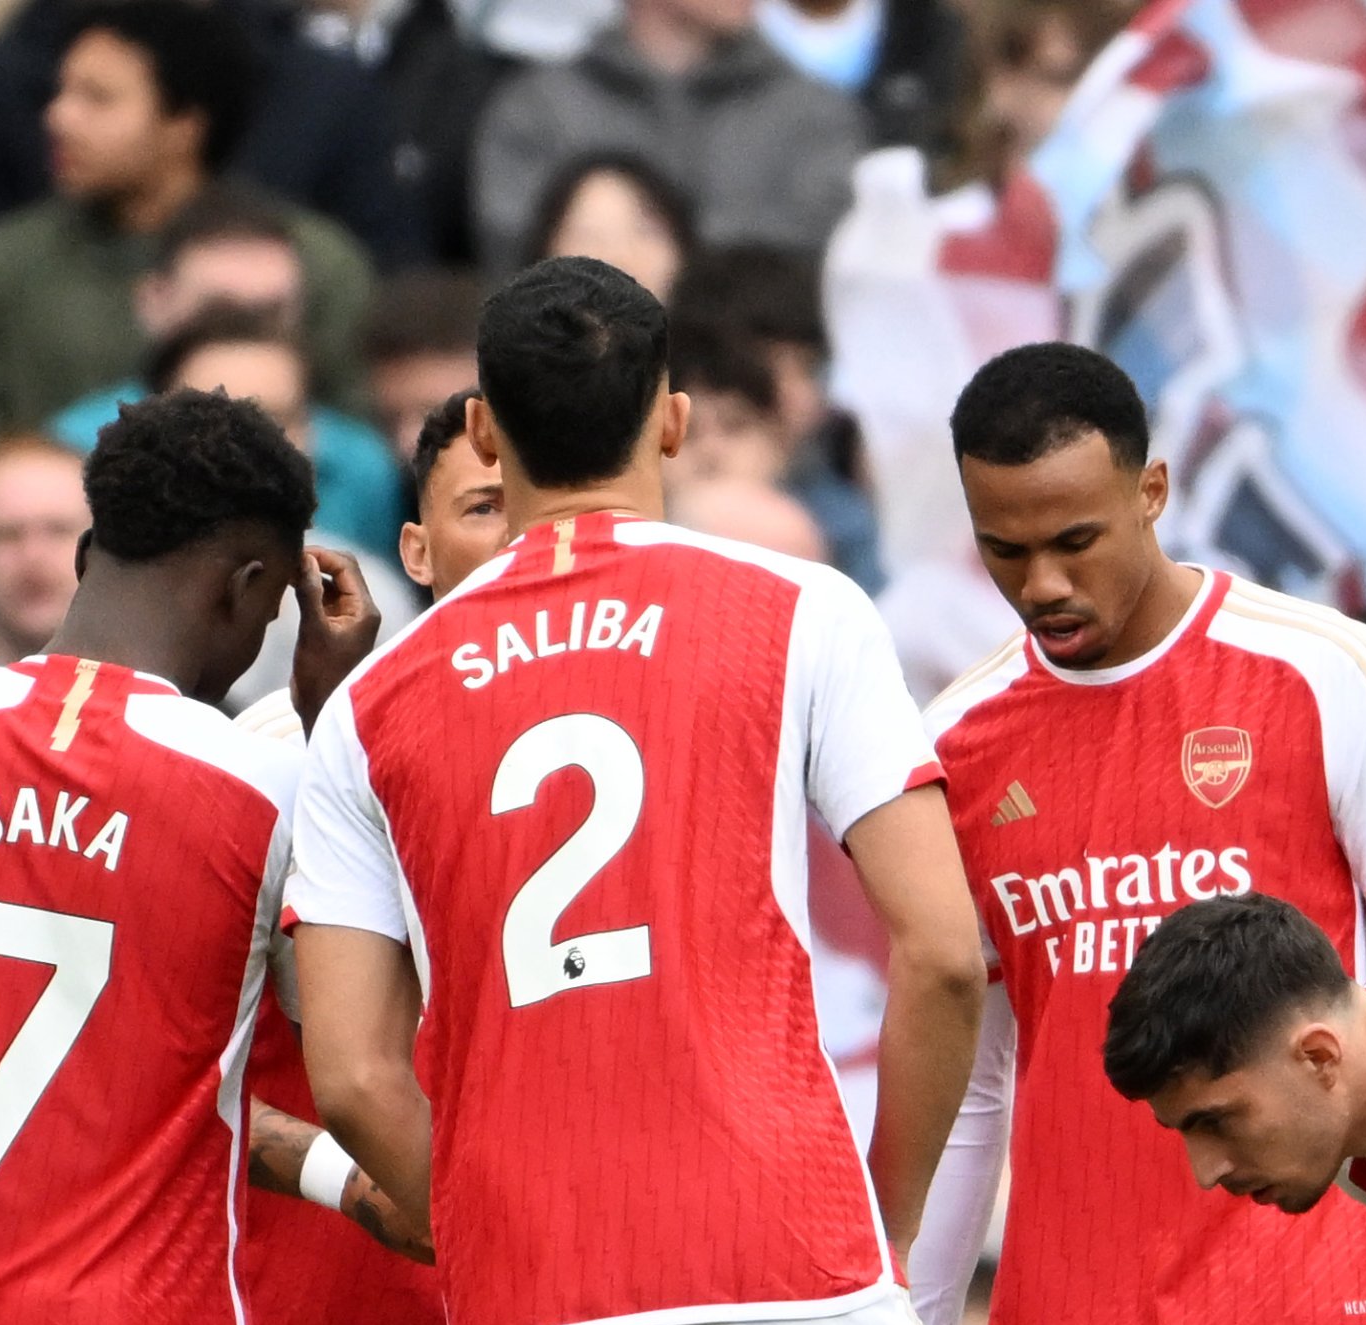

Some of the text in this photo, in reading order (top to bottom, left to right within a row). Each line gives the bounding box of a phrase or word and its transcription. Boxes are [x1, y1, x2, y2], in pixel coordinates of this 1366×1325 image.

[450, 598, 665, 691] SALIBA
[1192, 740, 1241, 755] Arsenal
[490, 712, 652, 1009] 2
[990, 842, 1252, 937] Emrates
